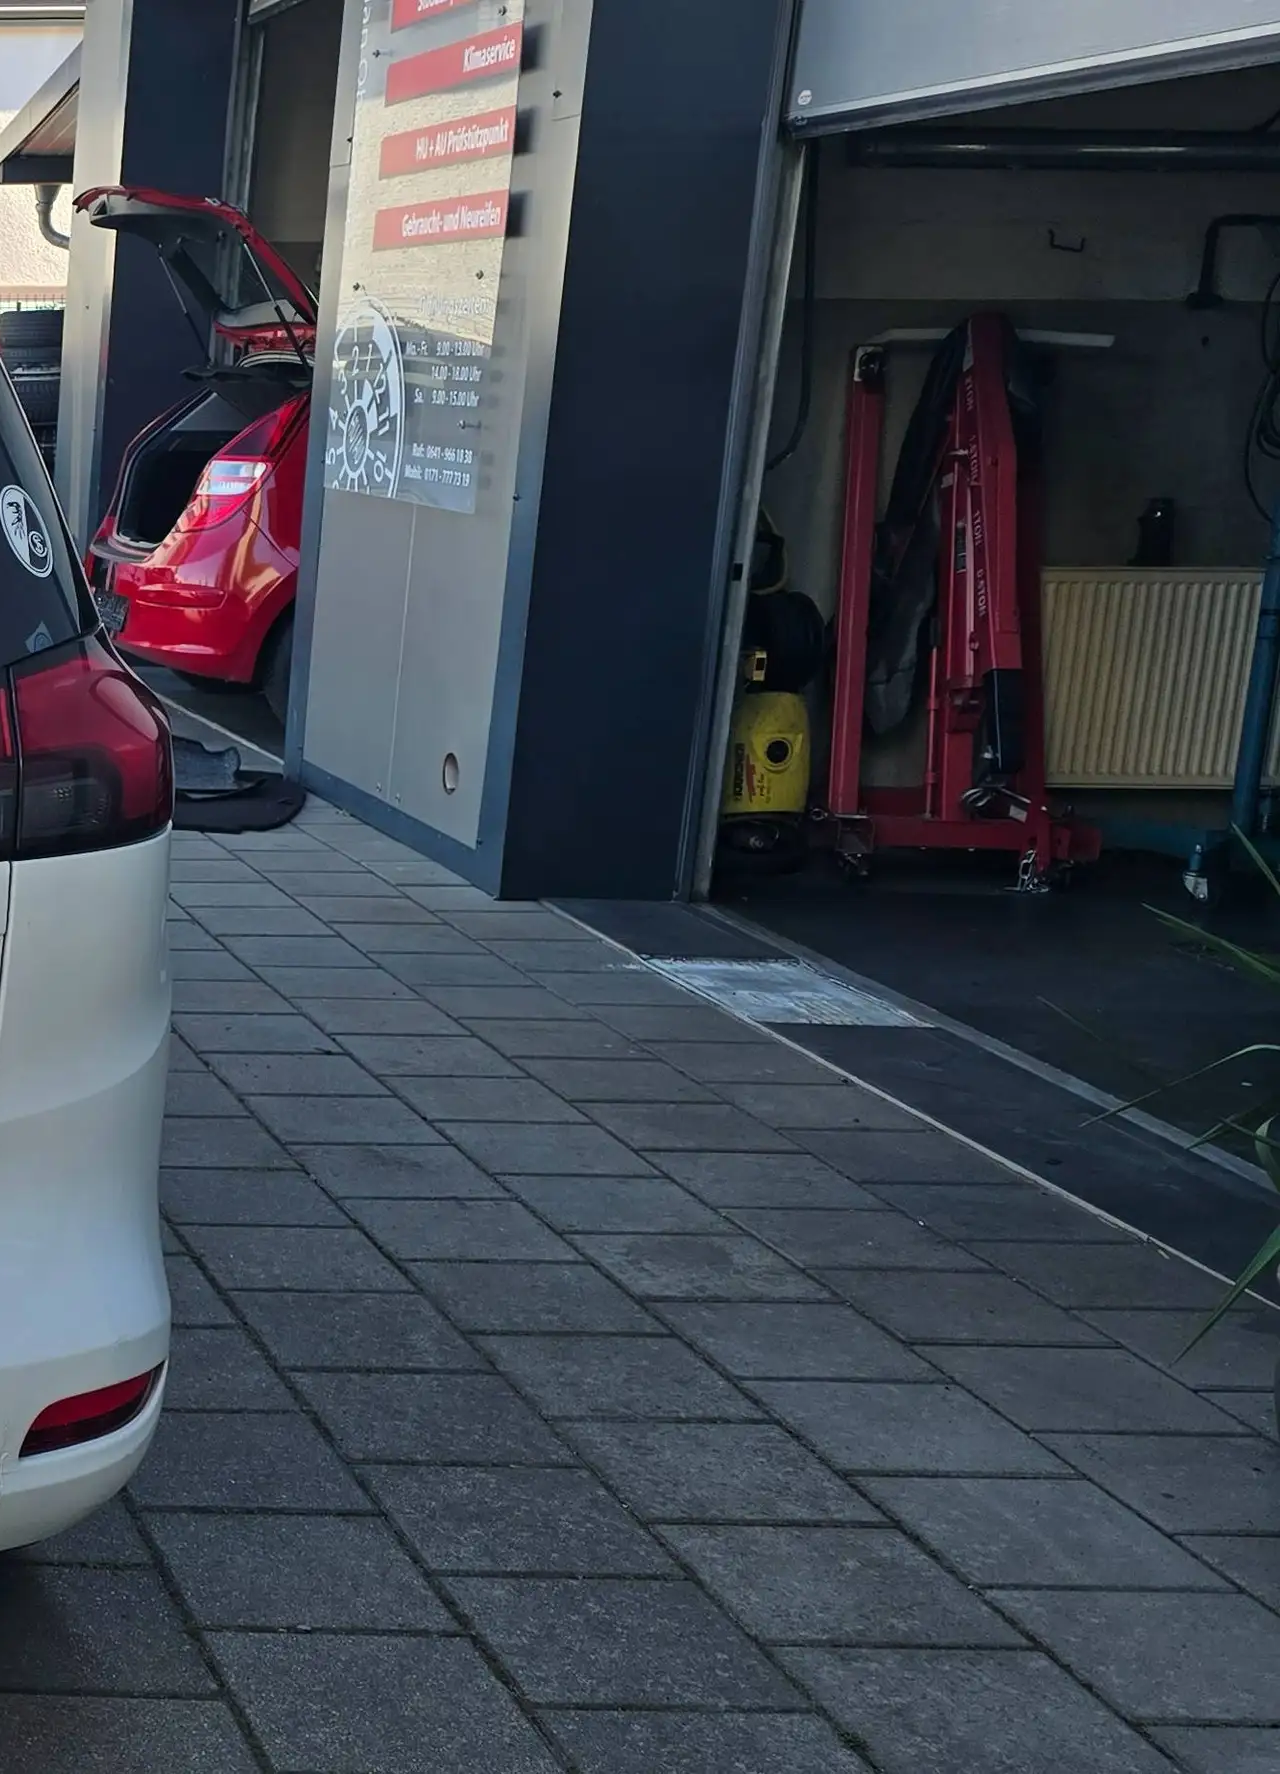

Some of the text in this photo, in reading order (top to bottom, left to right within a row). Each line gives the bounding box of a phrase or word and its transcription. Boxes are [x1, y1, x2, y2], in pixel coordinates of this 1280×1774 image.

[463, 35, 516, 73] Klimaservice
[416, 136, 429, 161] HU
[434, 132, 447, 156] AU
[442, 206, 460, 232] und
[470, 365, 482, 382] Uhr
[467, 390, 480, 407] Uhr
